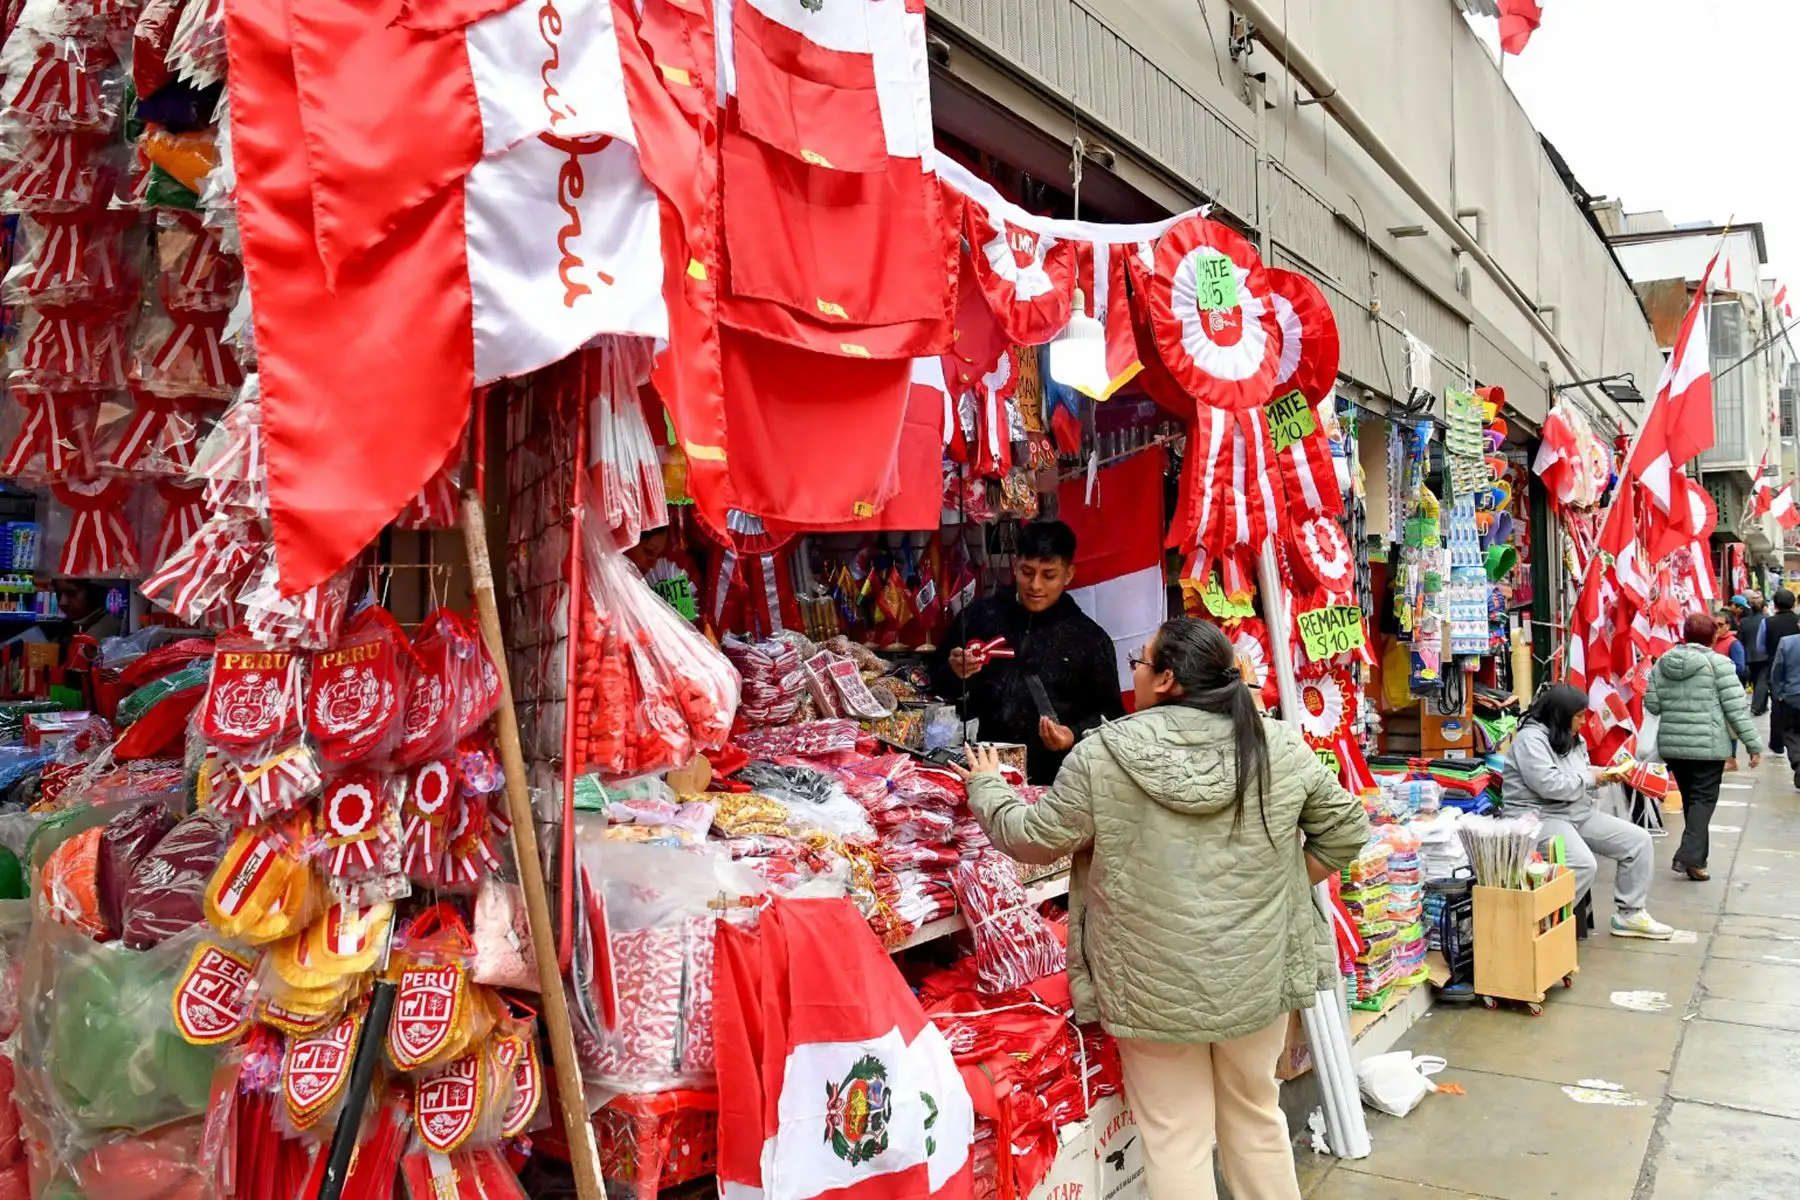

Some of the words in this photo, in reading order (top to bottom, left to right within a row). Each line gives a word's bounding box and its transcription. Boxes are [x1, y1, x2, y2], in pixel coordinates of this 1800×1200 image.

[538, 0, 577, 127] erú
[1300, 606, 1360, 638] REMATE
[222, 652, 292, 670] PERU
[321, 642, 382, 669] PERU
[200, 950, 251, 984] PER
[401, 966, 455, 991] PERÚ
[424, 1056, 476, 1080] ERÚ
